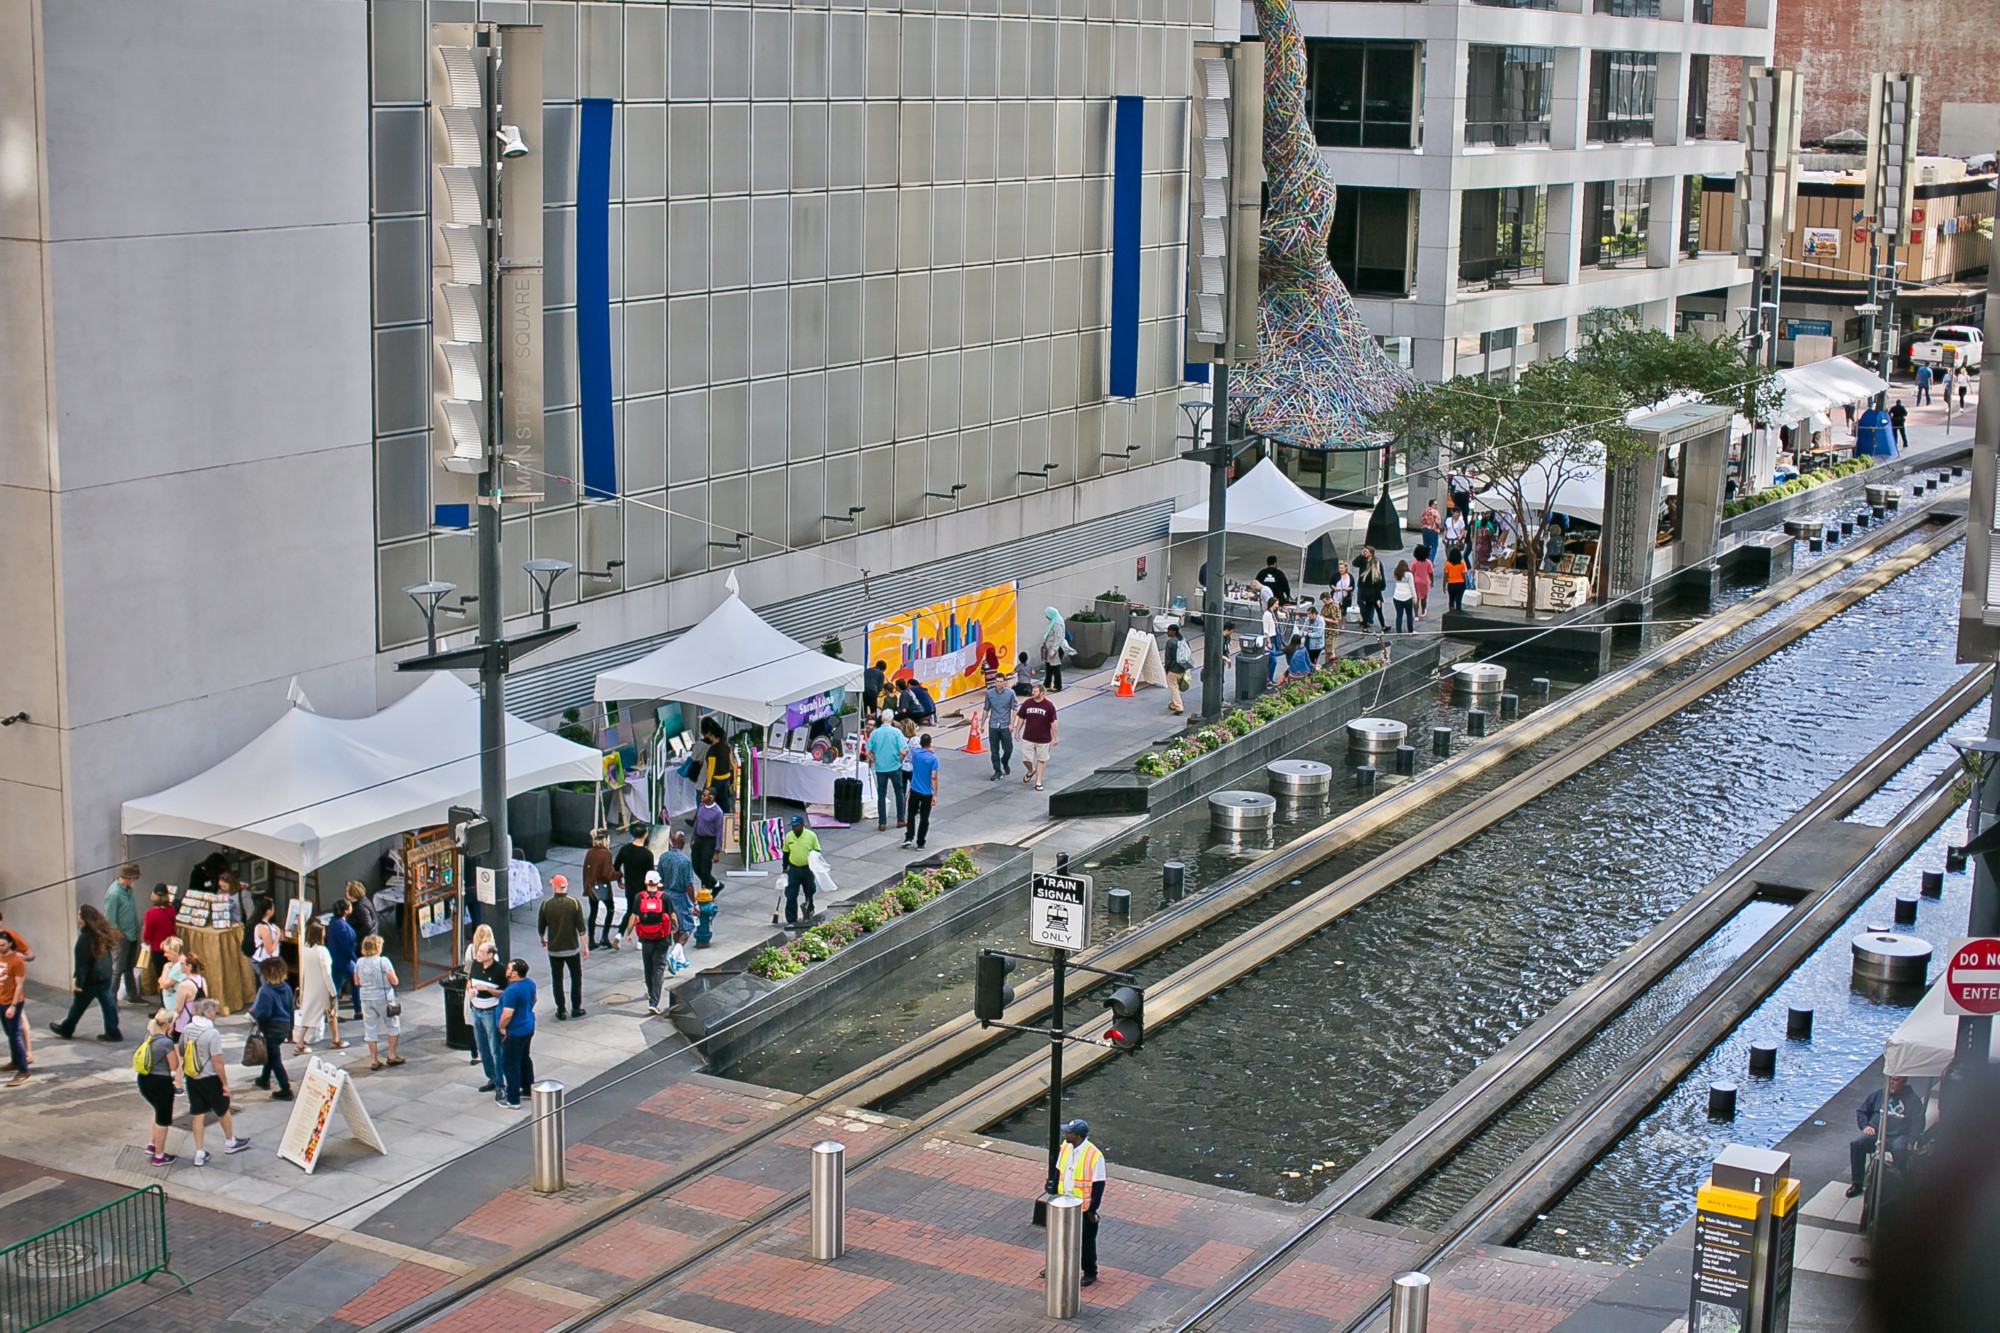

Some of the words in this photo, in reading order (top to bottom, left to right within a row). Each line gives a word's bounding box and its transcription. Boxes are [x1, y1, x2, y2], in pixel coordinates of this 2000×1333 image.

[516, 279, 530, 359] SQUARE
[516, 367, 531, 439] STREET
[517, 445, 531, 491] MAIN
[799, 698, 818, 715] Sarah
[1026, 707, 1046, 716] TRINITY
[1042, 877, 1077, 891] TRAIN
[1037, 888, 1080, 903] SIGNAL
[1042, 931, 1072, 943] ONLY
[1960, 953, 1979, 966] DO
[1728, 1221, 1742, 1229] Square
[1718, 1255, 1732, 1263] Library
[1727, 1251, 1740, 1259] Library
[1711, 1265, 1728, 1273] Houston
